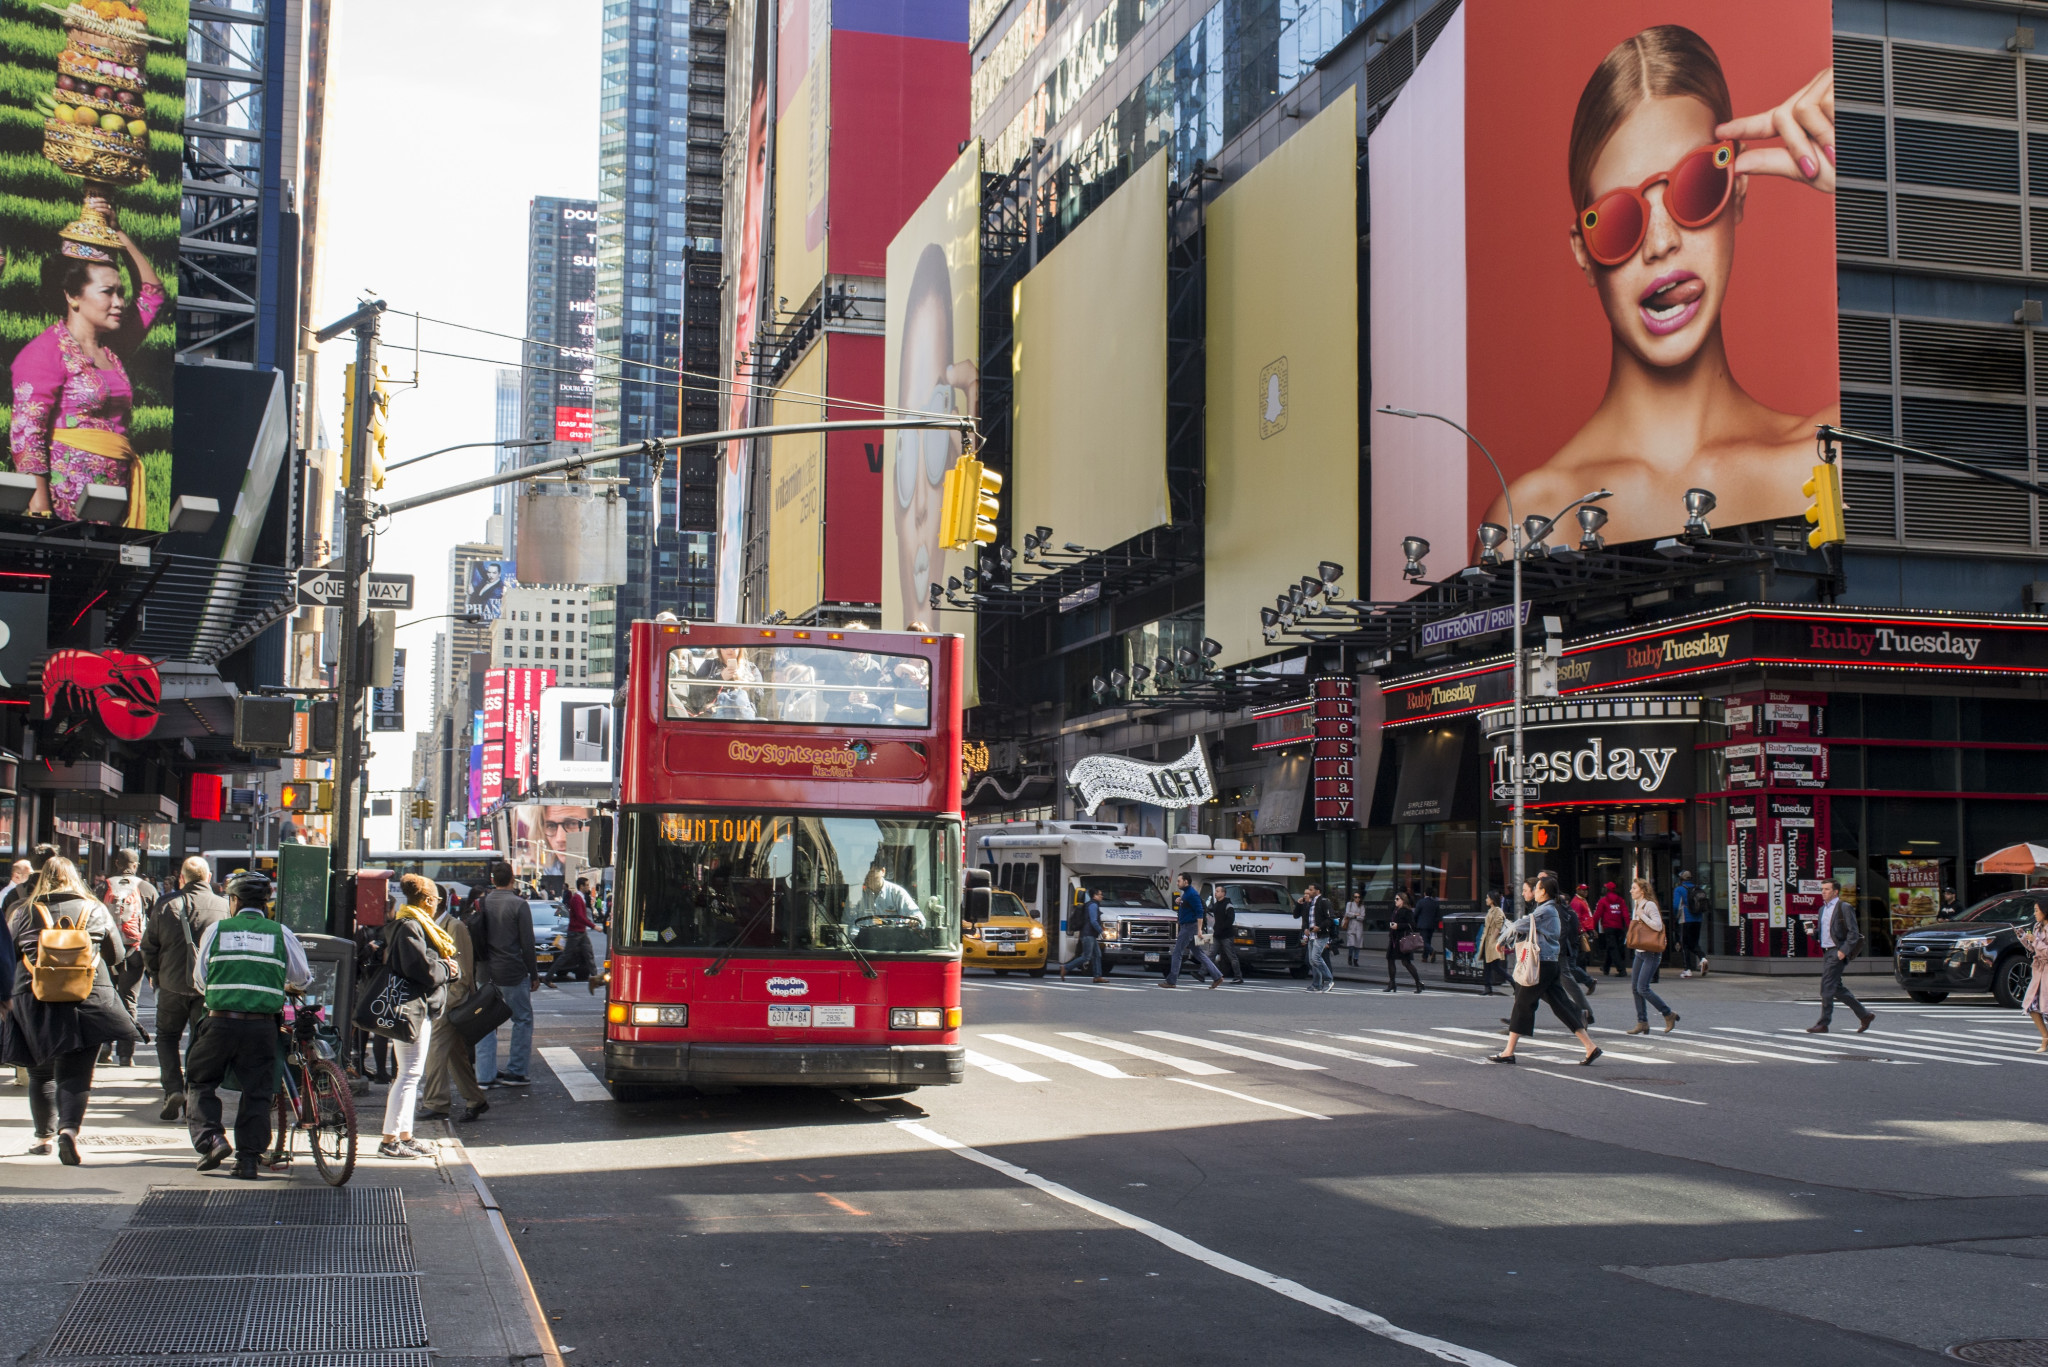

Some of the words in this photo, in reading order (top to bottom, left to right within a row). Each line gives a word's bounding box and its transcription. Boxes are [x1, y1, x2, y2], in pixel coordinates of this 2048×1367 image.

[800, 486, 816, 524] zero
[313, 581, 345, 596] ONE
[367, 584, 403, 599] WAY
[1424, 614, 1486, 643] OUTFRONT
[1626, 632, 1730, 669] RubyTuesday
[1809, 625, 1982, 660] RubyTuesday
[1406, 682, 1477, 711] RubyTuesday
[1769, 692, 1791, 702] Ruby
[1772, 711, 1803, 720] Tuesday
[1774, 705, 1794, 713] Ruby
[295, 717, 303, 750] REUTERS
[1337, 682, 1350, 815] Tuesday
[1773, 761, 1805, 770] Tuesday
[1148, 767, 1204, 800] LOFT
[1402, 808, 1424, 817] AMERICAN
[1424, 807, 1441, 815] DINING
[1407, 800, 1423, 809] SIMPLE
[1729, 805, 1755, 815] Tuesday
[1772, 803, 1811, 815] Tuesday
[1787, 829, 1799, 887] Tuesday
[1816, 846, 1828, 878] Ruby
[1230, 862, 1269, 873] verizon
[1890, 872, 1938, 883] BREAKFAST
[1742, 894, 1758, 904] Ruby
[1792, 894, 1815, 905] Ruby
[1787, 916, 1796, 958] Tuesday
[377, 986, 410, 1005] ARE
[370, 1000, 411, 1022] ONE
